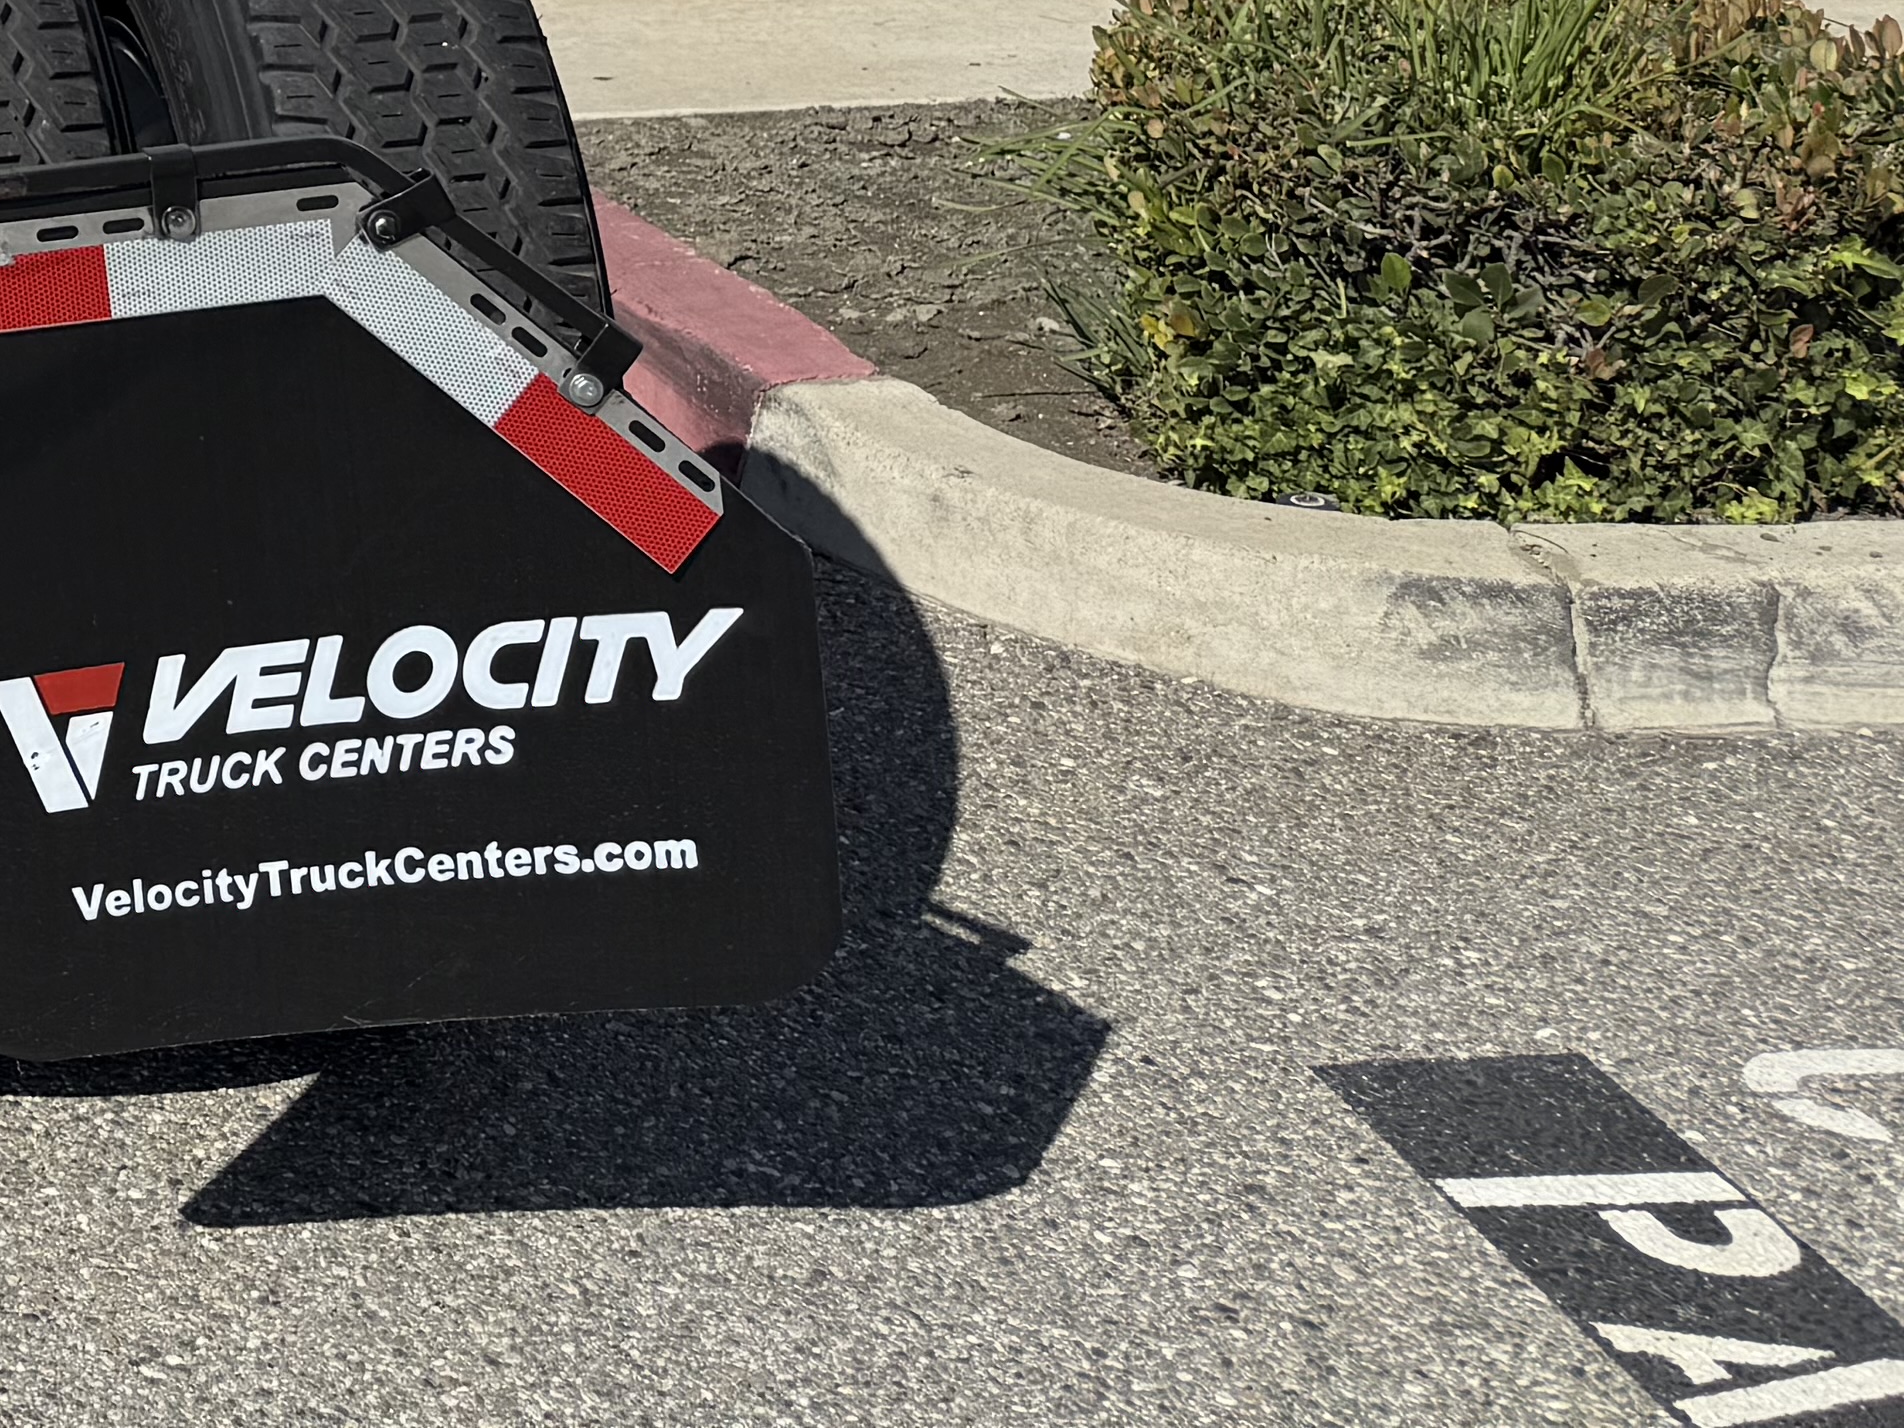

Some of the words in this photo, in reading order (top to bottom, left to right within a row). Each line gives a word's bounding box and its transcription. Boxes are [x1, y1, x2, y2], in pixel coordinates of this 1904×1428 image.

[143, 607, 744, 745] VELOCITY
[131, 746, 287, 801] TRUCK
[298, 725, 516, 781] CENTERS
[71, 838, 699, 921] VelocityTruckCenters.com
